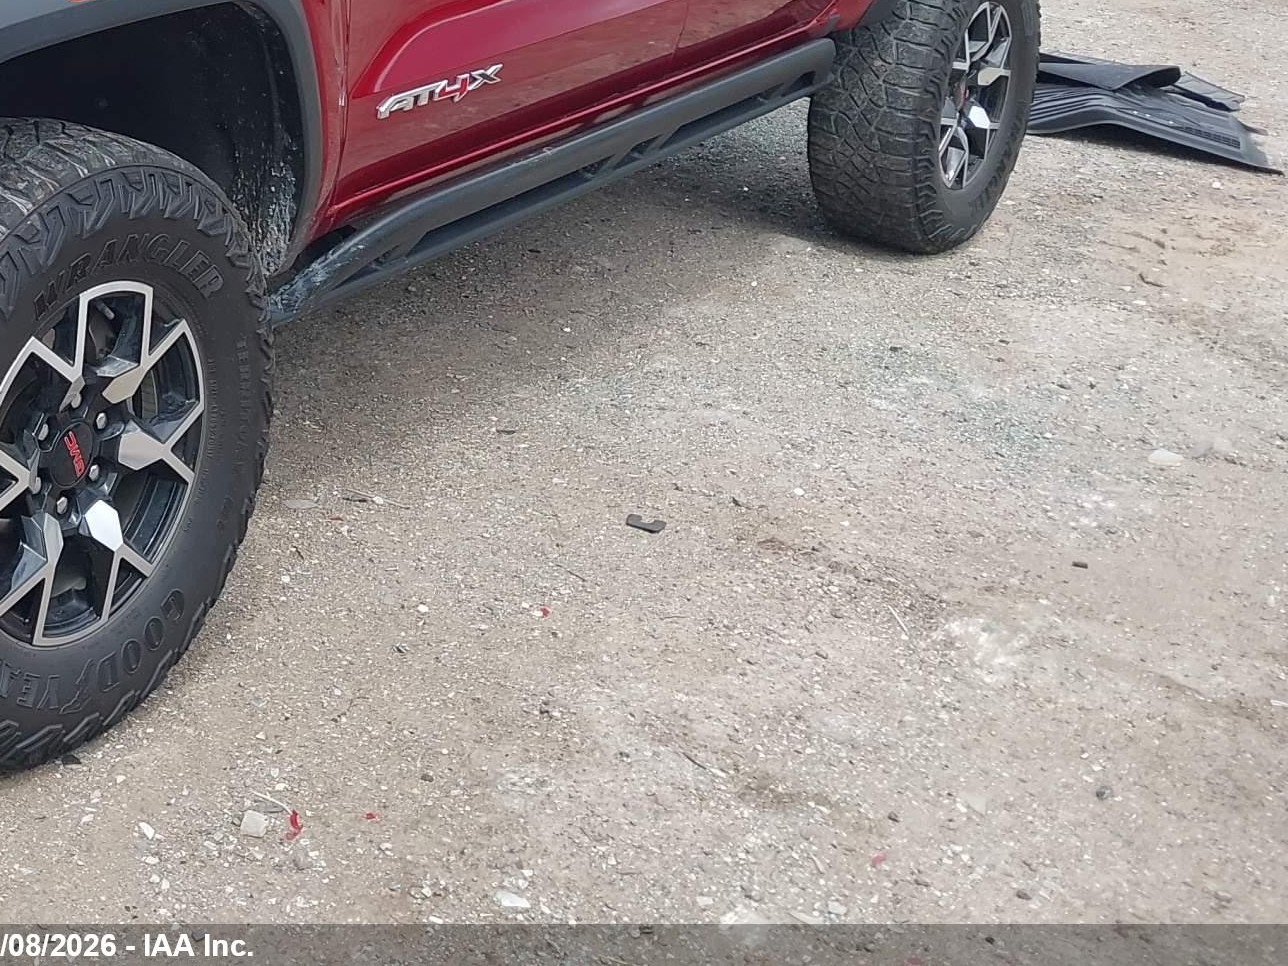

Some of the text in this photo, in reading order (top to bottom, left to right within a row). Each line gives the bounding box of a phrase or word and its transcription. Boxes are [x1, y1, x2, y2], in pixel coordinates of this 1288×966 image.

[375, 63, 504, 120] AT4X
[32, 233, 225, 322] WRANGLER
[63, 430, 85, 478] GMC
